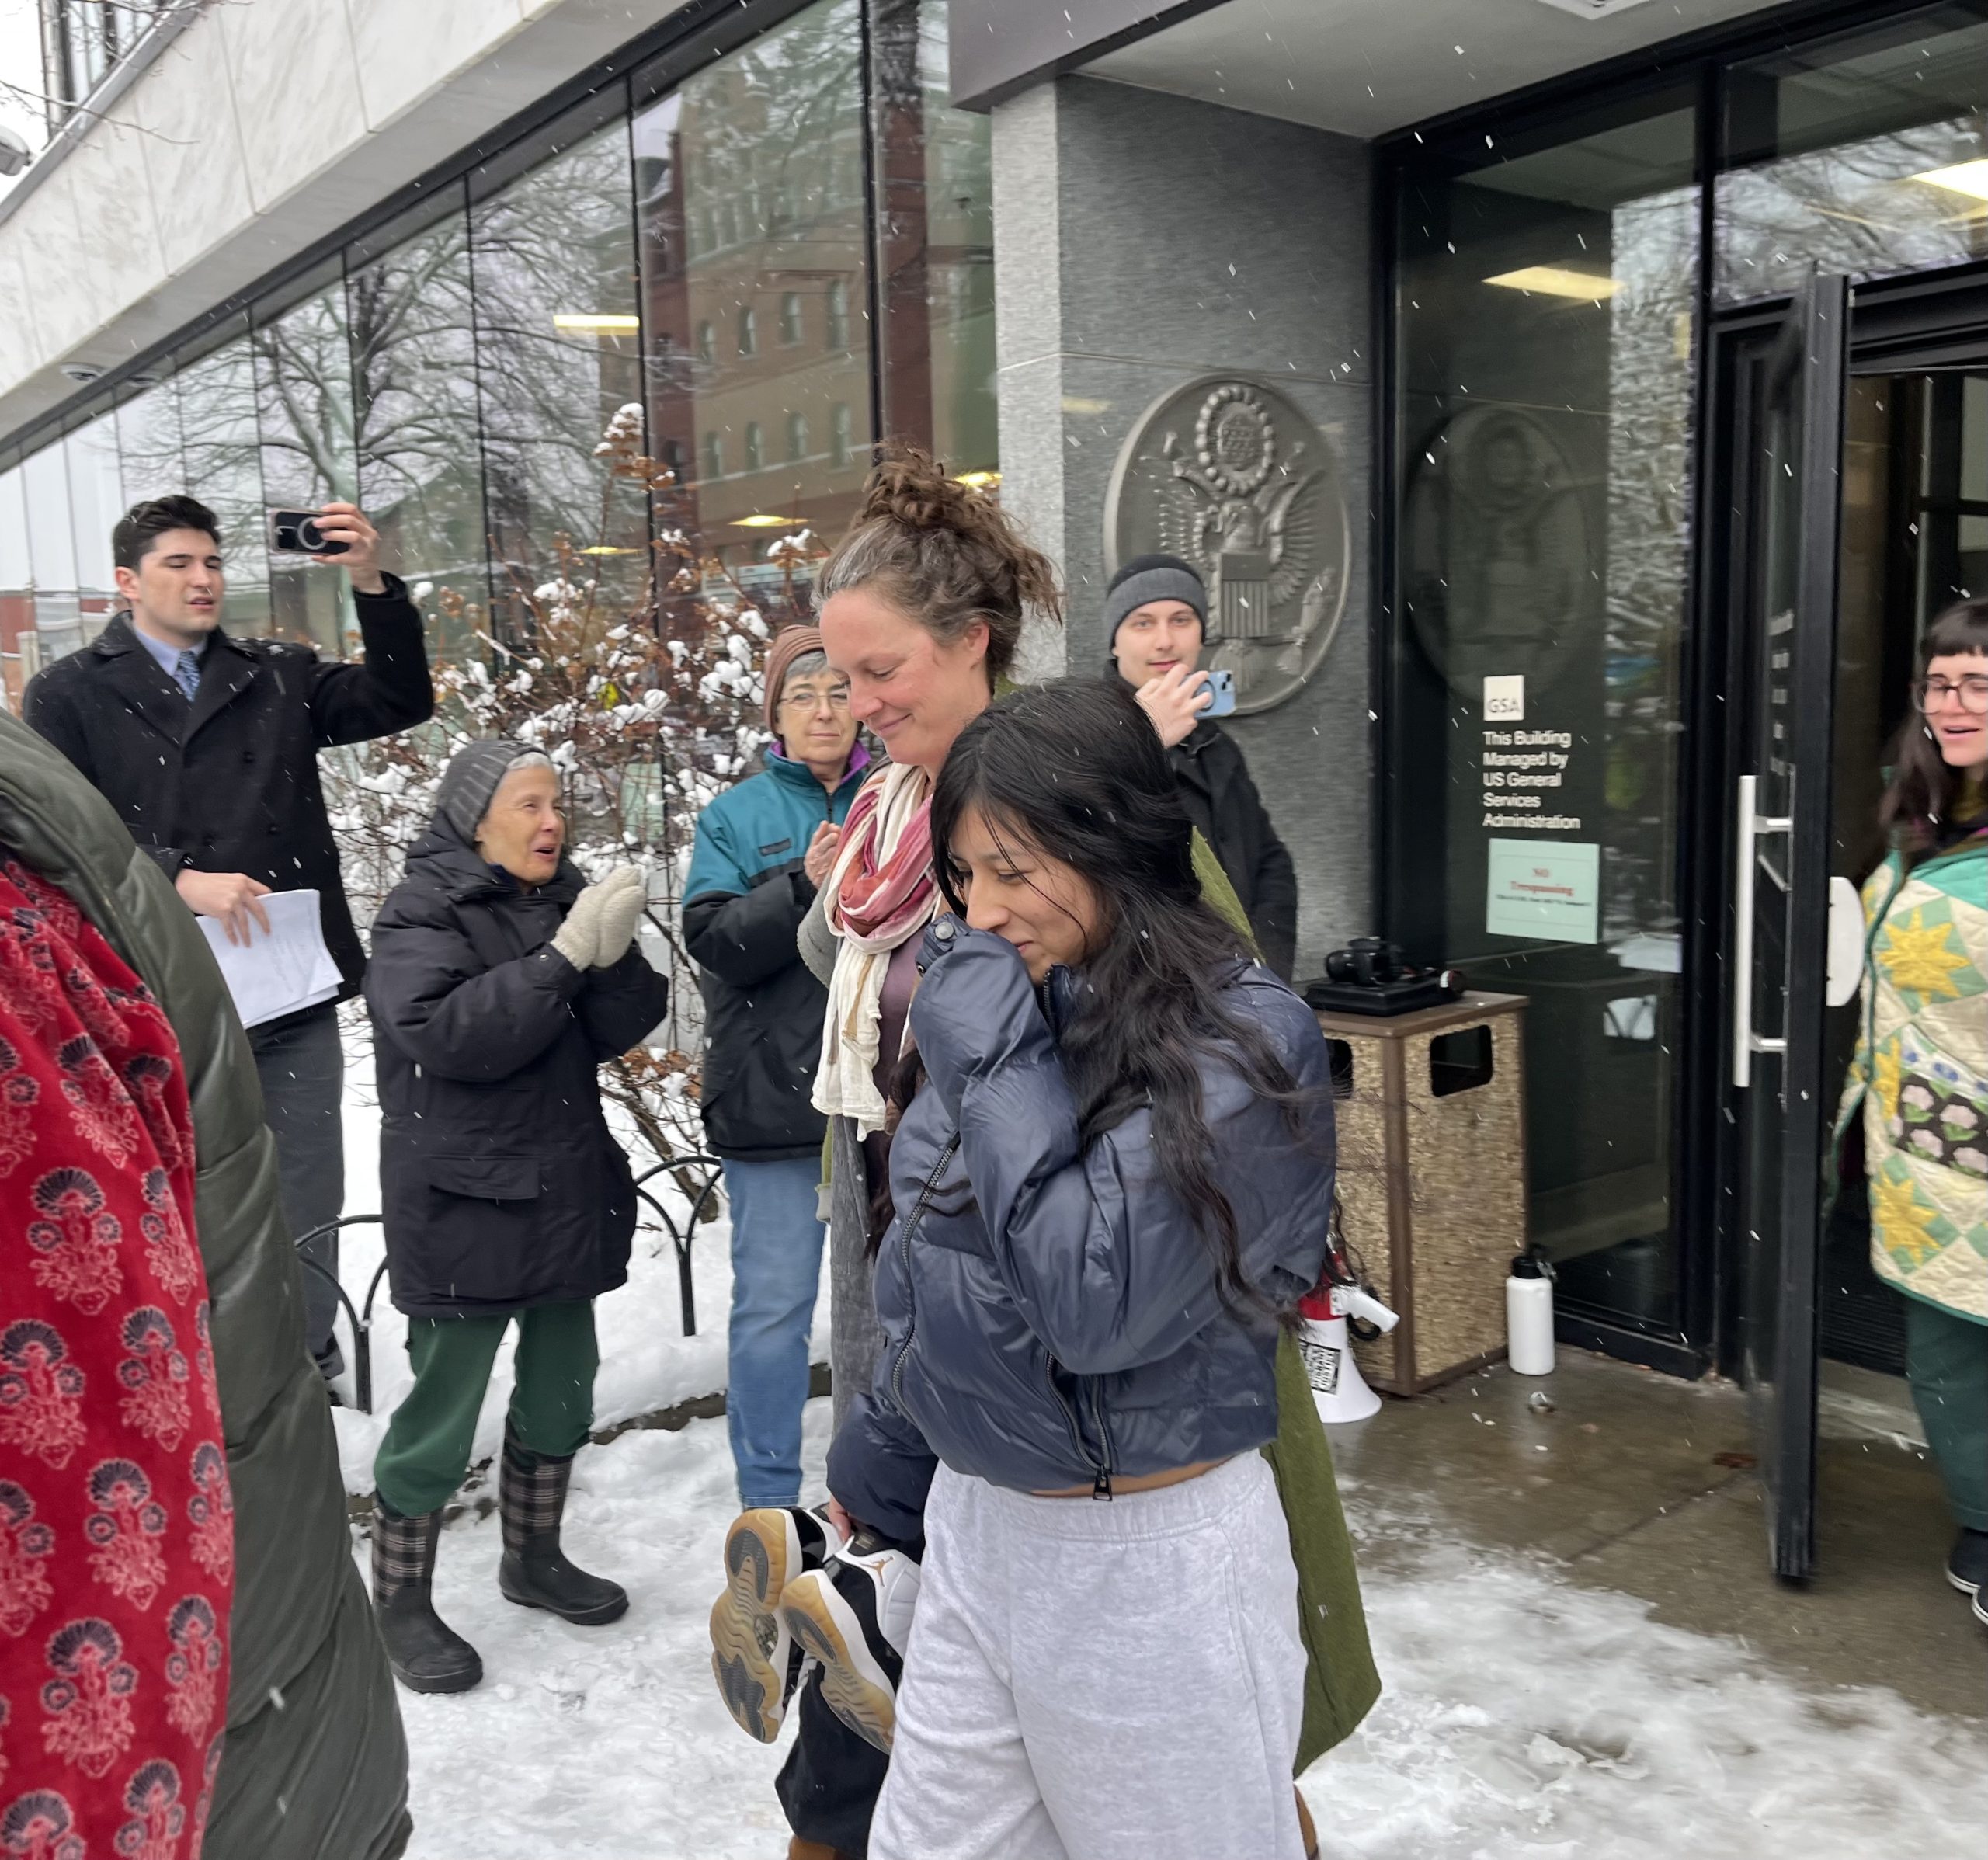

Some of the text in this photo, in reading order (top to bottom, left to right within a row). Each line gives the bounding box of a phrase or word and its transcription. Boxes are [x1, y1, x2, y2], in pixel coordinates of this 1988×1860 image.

[1489, 698, 1521, 713] GSA
[1482, 730, 1572, 748] This Building
[1482, 751, 1569, 769] Managed by
[1482, 772, 1562, 787] US General
[1482, 792, 1541, 808] Services
[1482, 812, 1581, 829] Administration
